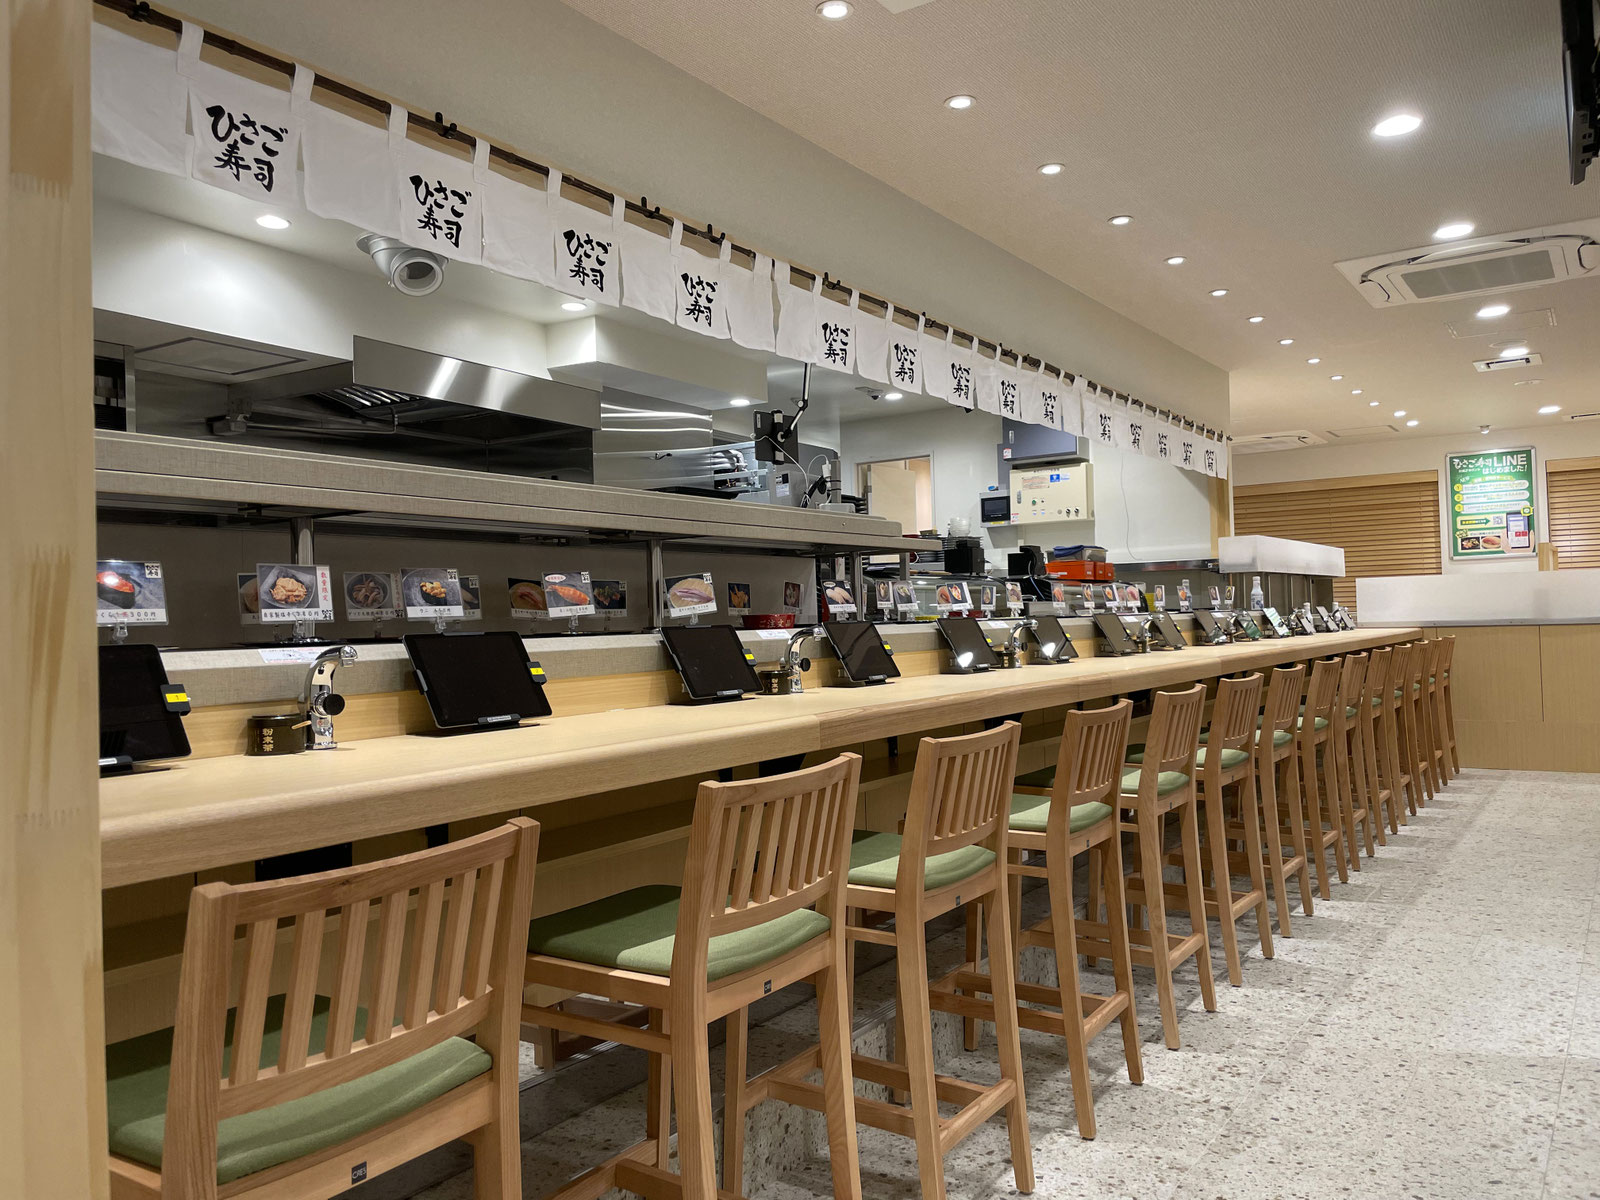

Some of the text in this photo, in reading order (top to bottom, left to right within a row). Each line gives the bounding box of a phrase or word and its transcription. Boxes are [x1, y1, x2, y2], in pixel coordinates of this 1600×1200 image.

[205, 105, 288, 157] ひさご
[214, 139, 273, 192] 寿司
[408, 174, 472, 218] ひさご
[417, 203, 462, 248] 寿司
[563, 230, 612, 266] ひさご
[569, 254, 604, 292] 寿司
[681, 273, 718, 303] ひさご
[685, 296, 712, 327] 寿司
[822, 323, 850, 346] ひさご
[824, 341, 847, 366] 寿司
[894, 343, 917, 366] ひさご
[895, 361, 914, 384] 寿司
[951, 363, 971, 383] ひさご
[953, 379, 969, 400] 寿司
[1001, 380, 1017, 398] ひさご
[1003, 394, 1014, 414] 寿司
[262, 728, 274, 752] 粉末茶
